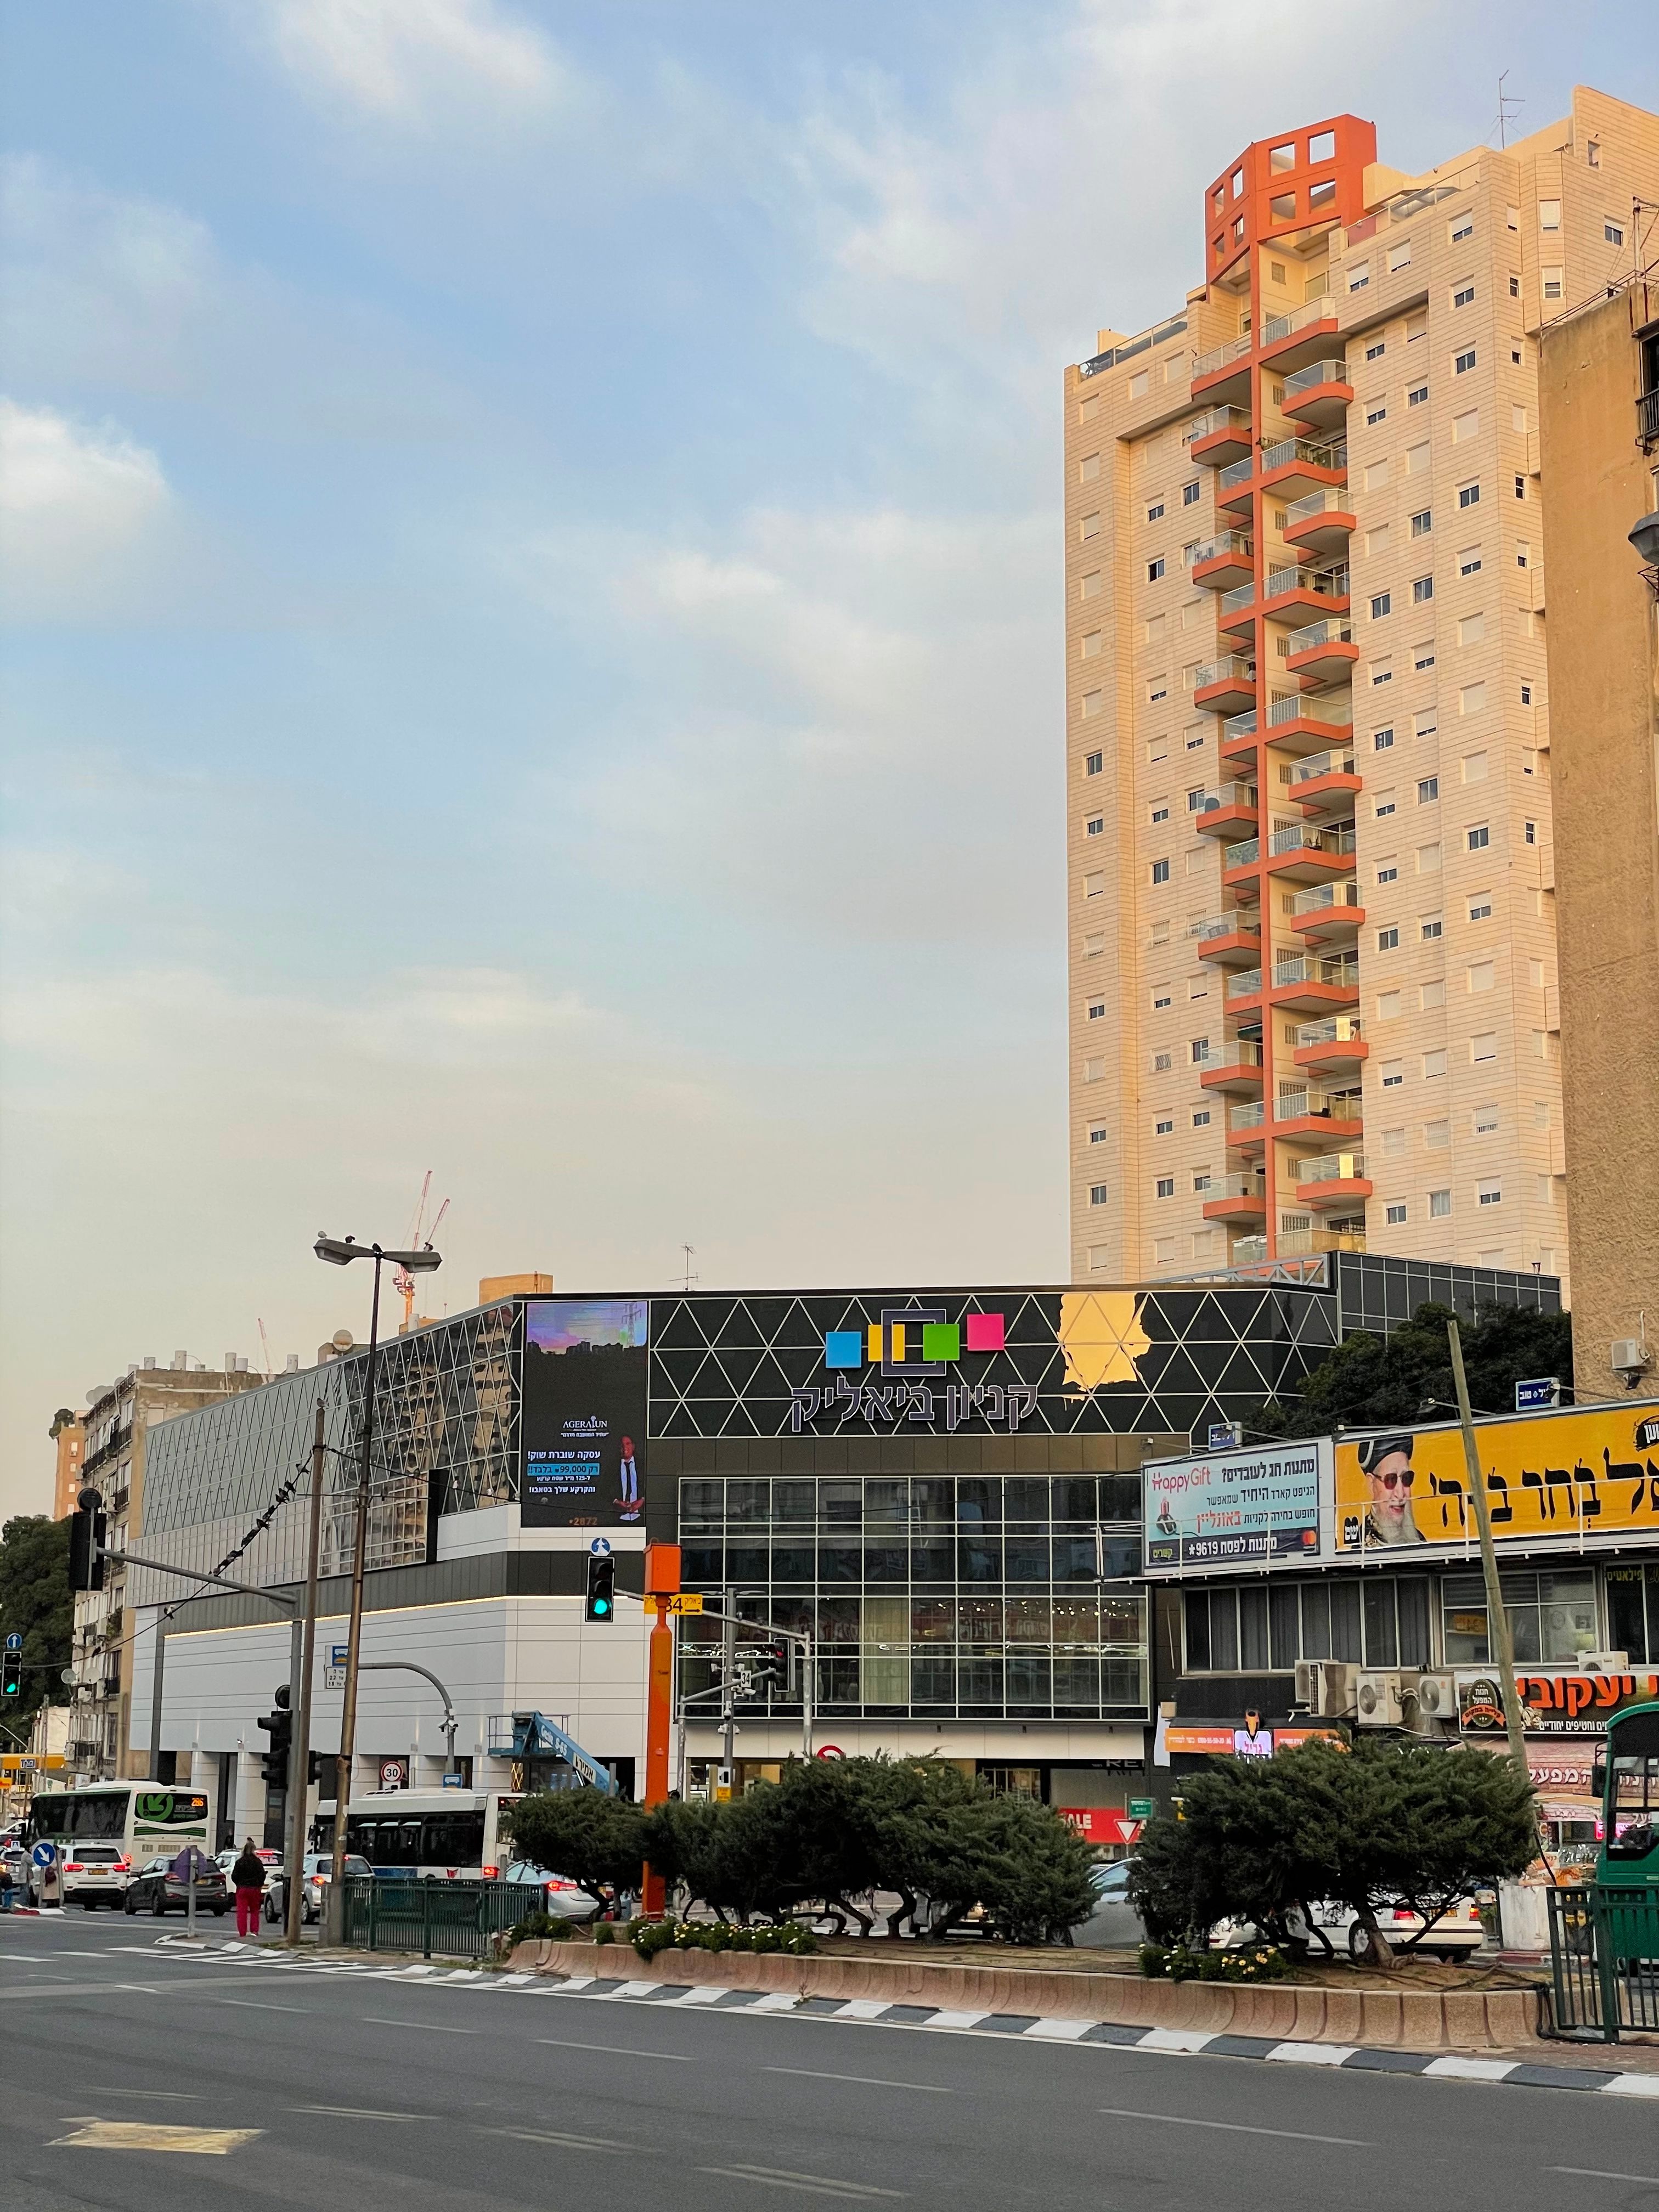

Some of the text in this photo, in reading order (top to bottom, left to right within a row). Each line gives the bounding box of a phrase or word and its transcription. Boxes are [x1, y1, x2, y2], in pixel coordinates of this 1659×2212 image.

[791, 1376, 1038, 1432] קניון ביאליק
[528, 1451, 546, 1461] שוק!
[577, 1451, 601, 1460] עסקה
[588, 1466, 598, 1475] רק
[1221, 1459, 1314, 1483] מתנות חג לעובדים?
[1206, 1486, 1315, 1506] הגיפט קארד היחיד שמאפשר
[1197, 1509, 1315, 1533] חופש בחירה לקניות באונליין
[1220, 1537, 1246, 1554] לפסח
[1248, 1536, 1277, 1551] מתנות
[742, 1673, 750, 1684] 34
[1472, 1695, 1492, 1704] המפעל
[1517, 1675, 1633, 1717] יעקובי
[1566, 1720, 1594, 1731] וחטיפים
[1244, 1740, 1263, 1755] גריל
[1106, 1759, 1145, 1768] RE
[386, 1768, 398, 1777] 30
